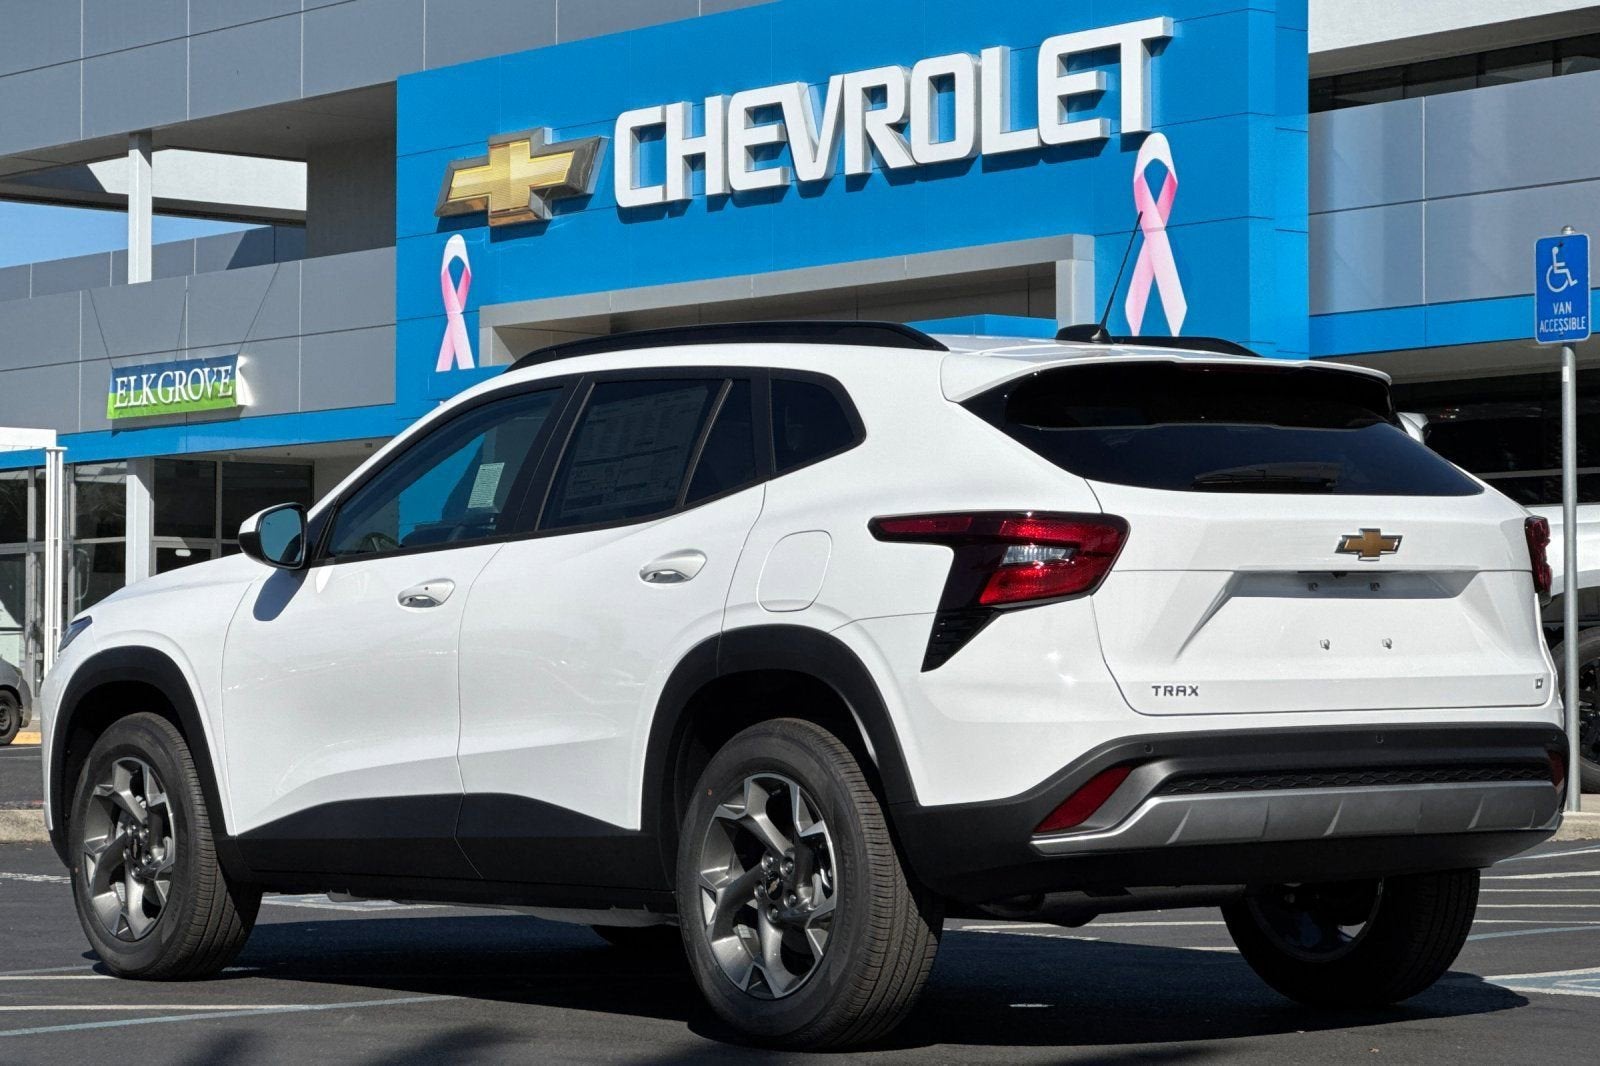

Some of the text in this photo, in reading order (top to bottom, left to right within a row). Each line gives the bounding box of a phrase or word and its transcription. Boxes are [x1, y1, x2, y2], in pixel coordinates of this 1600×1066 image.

[614, 16, 1174, 208] CHEVROLET
[1553, 301, 1573, 316] VAN
[1540, 316, 1587, 333] ACCESSIBLE
[1151, 685, 1199, 697] TRAX
